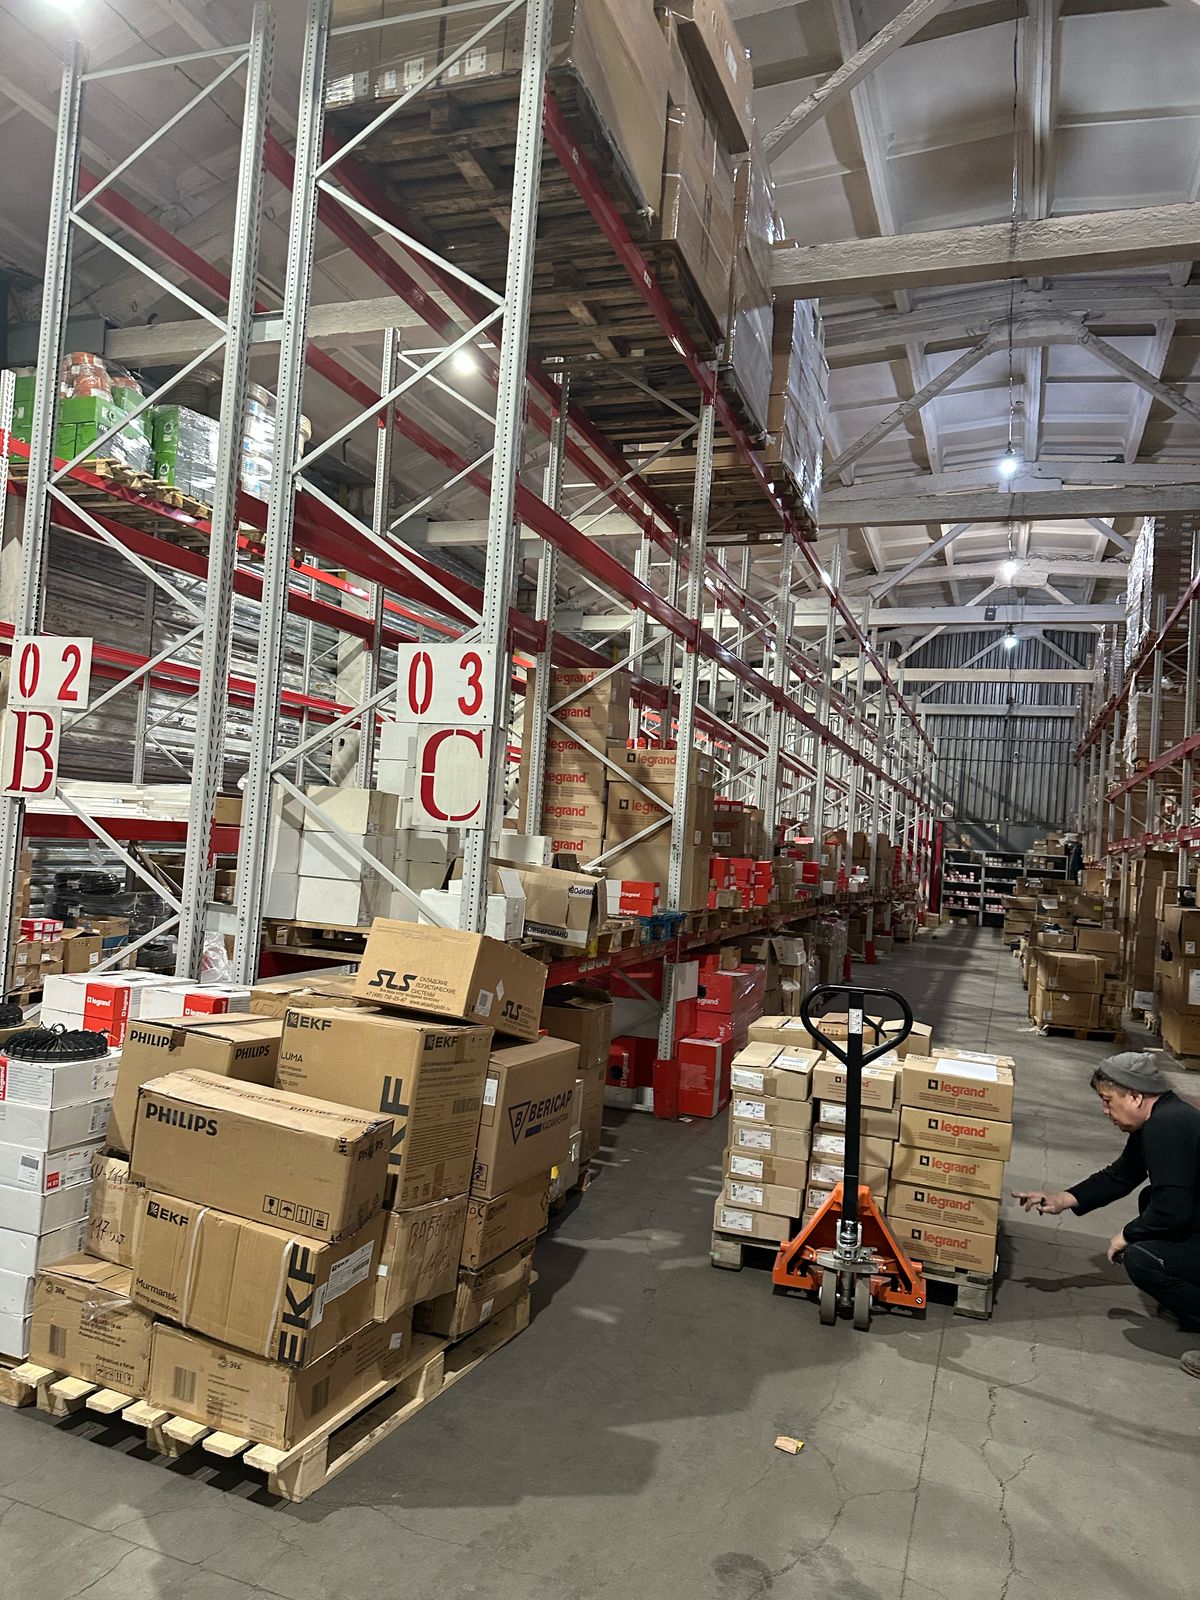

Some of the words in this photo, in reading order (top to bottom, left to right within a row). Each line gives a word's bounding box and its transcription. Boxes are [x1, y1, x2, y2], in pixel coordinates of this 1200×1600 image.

[553, 705, 592, 720] egrand
[547, 737, 589, 752] legran
[638, 752, 677, 767] legrand
[544, 769, 587, 785] legrand
[544, 803, 586, 817] legrand
[631, 799, 664, 815] legra
[551, 839, 585, 852] grand
[367, 969, 418, 992] SLS
[92, 997, 111, 1007] legrand
[697, 998, 719, 1006] egrand
[300, 1016, 332, 1031] EKF
[435, 1036, 459, 1048] EKF
[235, 1045, 270, 1060] PHILIPS
[281, 1051, 303, 1062] LUMA
[941, 1080, 986, 1098] legrand
[528, 1090, 573, 1122] BERICAP
[145, 1102, 218, 1137] PHILIPS
[941, 1120, 986, 1138] legrand
[932, 1156, 977, 1175] legrand
[927, 1192, 971, 1211] legrand
[160, 1207, 189, 1227] EKF
[924, 1230, 968, 1249] legrand
[135, 1277, 178, 1303] Murmansk
[277, 1243, 316, 1368] EKF
